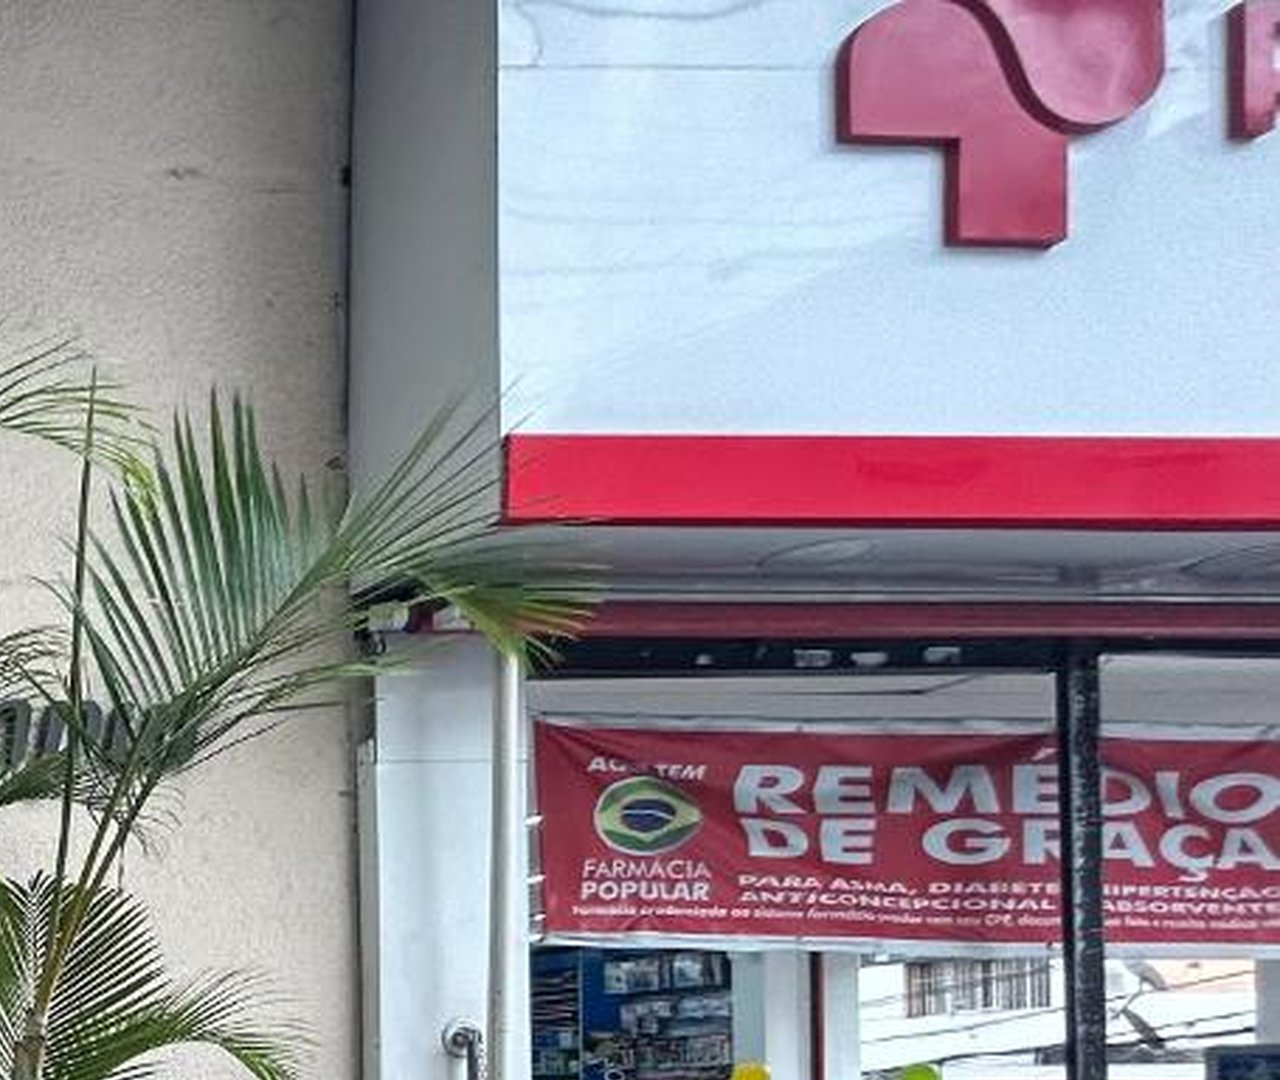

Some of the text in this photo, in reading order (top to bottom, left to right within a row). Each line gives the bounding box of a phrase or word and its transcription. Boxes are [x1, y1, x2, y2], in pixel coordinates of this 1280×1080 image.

[654, 764, 707, 780] TEM
[741, 818, 1280, 882] DE GRAÇA
[583, 858, 712, 880] FARMÁCIA
[580, 881, 709, 901] POPULAR
[739, 874, 822, 890] PARA
[928, 881, 1061, 895] DIABETE
